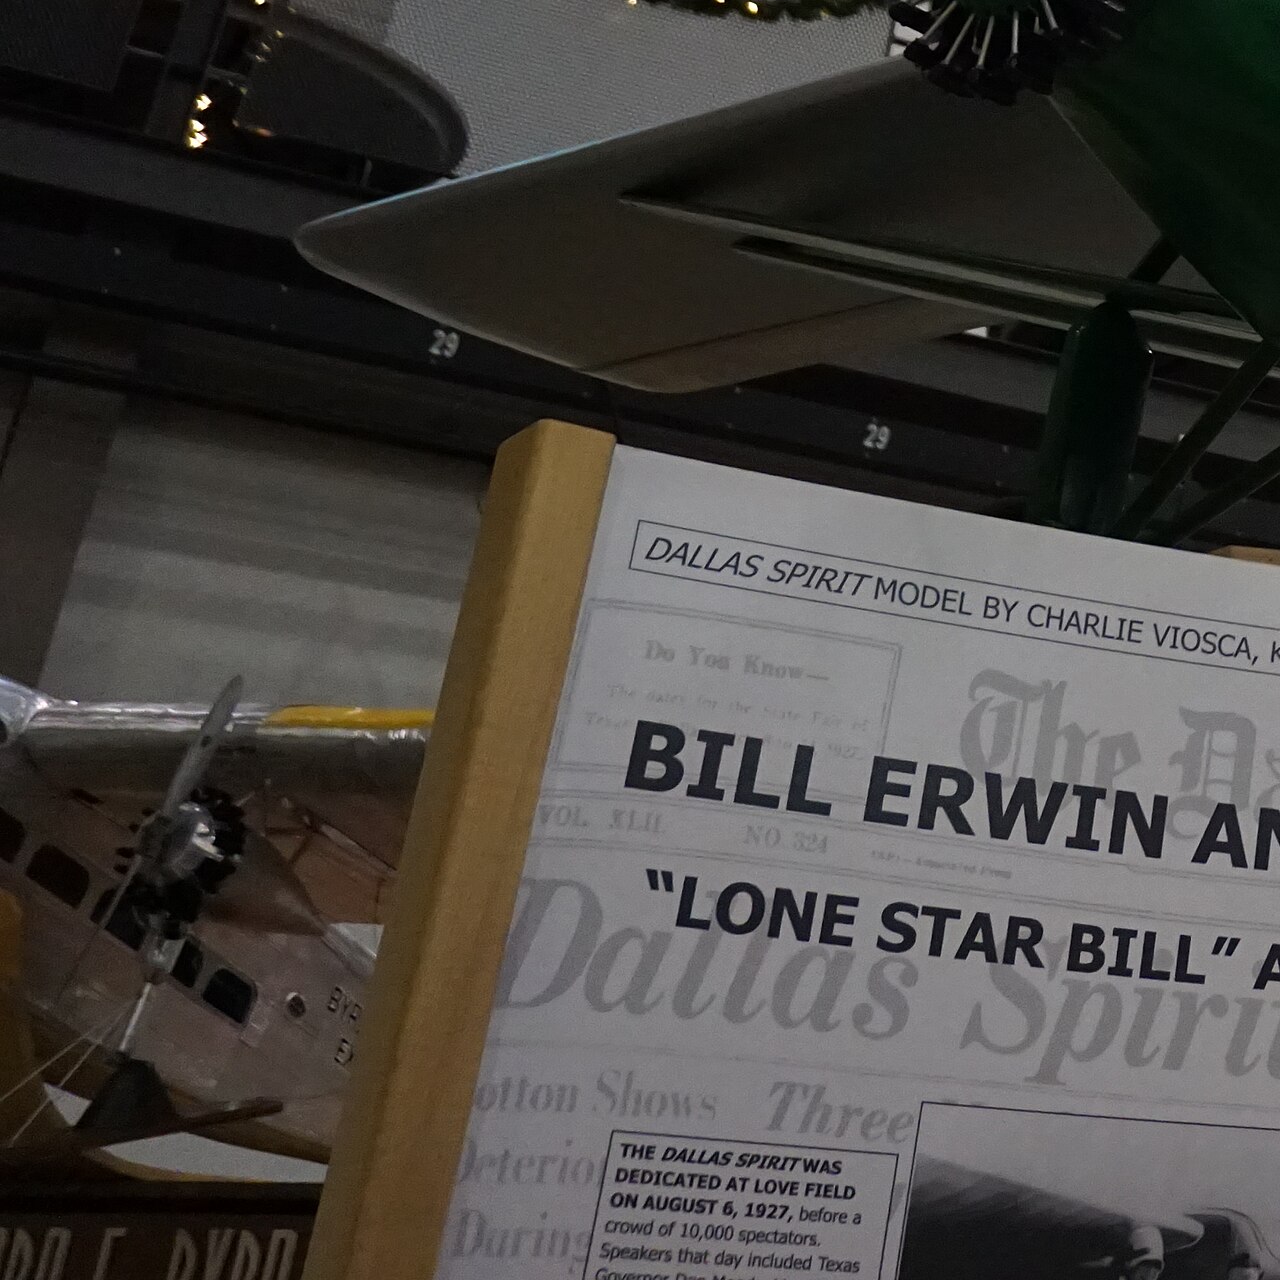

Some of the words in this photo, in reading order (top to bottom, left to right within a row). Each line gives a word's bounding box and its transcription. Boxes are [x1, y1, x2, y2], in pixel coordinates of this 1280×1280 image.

[428, 329, 461, 359] 29
[863, 424, 891, 451] 29
[645, 537, 763, 577] DALLAS
[767, 560, 871, 596] SPIRIT
[874, 577, 971, 615] MODEL
[983, 595, 1018, 622] BY
[1027, 604, 1143, 643] CHARLIE
[1153, 623, 1259, 665] VIOSCA,
[624, 720, 832, 816] BILL
[862, 755, 1168, 859] ERWIN
[645, 868, 859, 947] “LONE
[876, 901, 1044, 969] STAR
[1066, 923, 1241, 984] BILL”
[497, 877, 920, 1040] Dallas
[475, 1076, 580, 1113] otton
[594, 1069, 718, 1120] Shows
[768, 1080, 915, 1144] Three
[620, 1143, 656, 1161] THE
[661, 1147, 733, 1167] DALLAS
[735, 1154, 801, 1171] SPIRIT
[803, 1158, 842, 1174] WAS
[614, 1168, 721, 1190] DEDICATED
[726, 1177, 748, 1192] AT
[754, 1179, 799, 1197] LOVE
[804, 1182, 856, 1201] FIELD
[610, 1192, 637, 1209] ON
[643, 1195, 718, 1215] AUGUST
[722, 1201, 738, 1219] 6,
[745, 1203, 794, 1223] 1927,
[799, 1206, 847, 1224] before
[852, 1213, 862, 1225] a
[605, 1220, 653, 1236] crowd
[658, 1221, 676, 1237] of
[680, 1222, 734, 1242] 10,000
[738, 1227, 821, 1247] spectators.
[599, 1243, 672, 1263] Speakers
[677, 1246, 709, 1263] that
[714, 1250, 744, 1269] day
[748, 1252, 811, 1271] included
[818, 1255, 861, 1274] Texas
